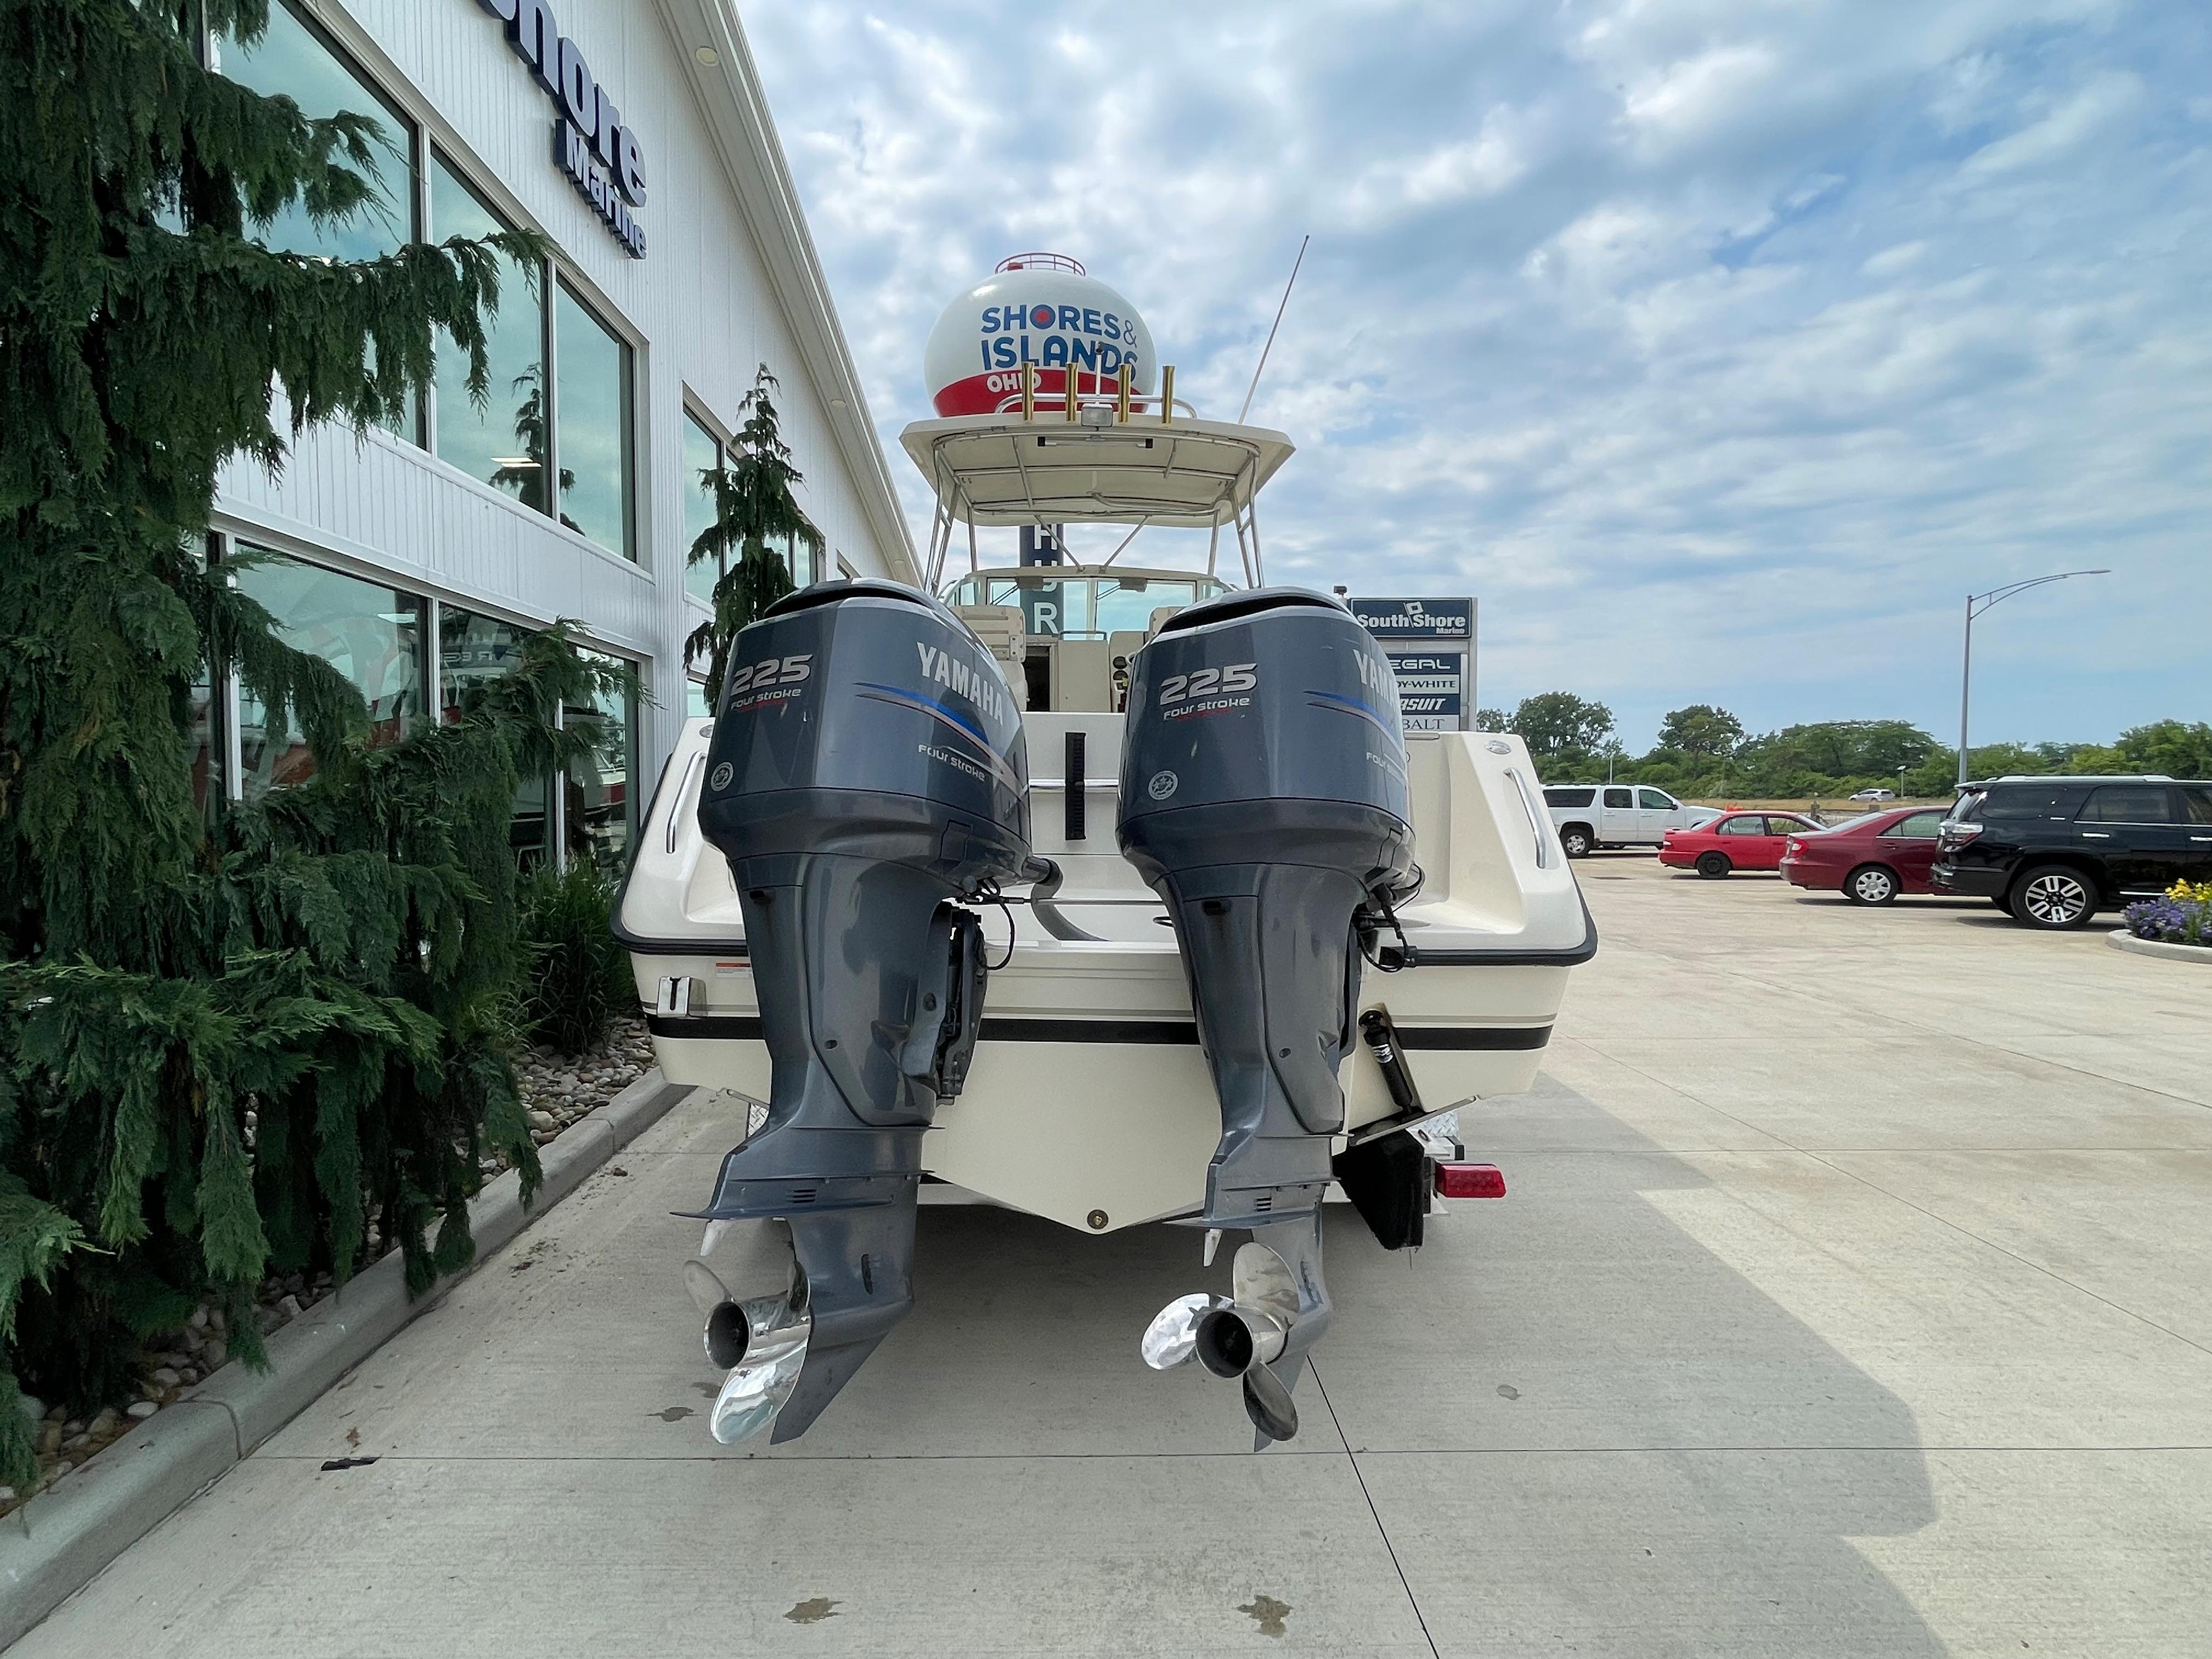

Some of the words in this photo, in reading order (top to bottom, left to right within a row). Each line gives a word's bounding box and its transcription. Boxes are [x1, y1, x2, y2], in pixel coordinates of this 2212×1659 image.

[477, 0, 647, 207] hore
[556, 118, 647, 259] Marine
[981, 304, 1121, 340] SHORES
[1124, 319, 1138, 348] &
[981, 335, 1138, 383] ISLANDS
[1357, 614, 1409, 628] South
[1413, 614, 1466, 628] Shore
[730, 653, 813, 696] 225
[917, 641, 1004, 726] YAMAHA
[1159, 663, 1257, 706] 225
[1389, 659, 1451, 669] EGAL
[1400, 698, 1446, 711] RSUIT
[1403, 719, 1445, 730] BALT
